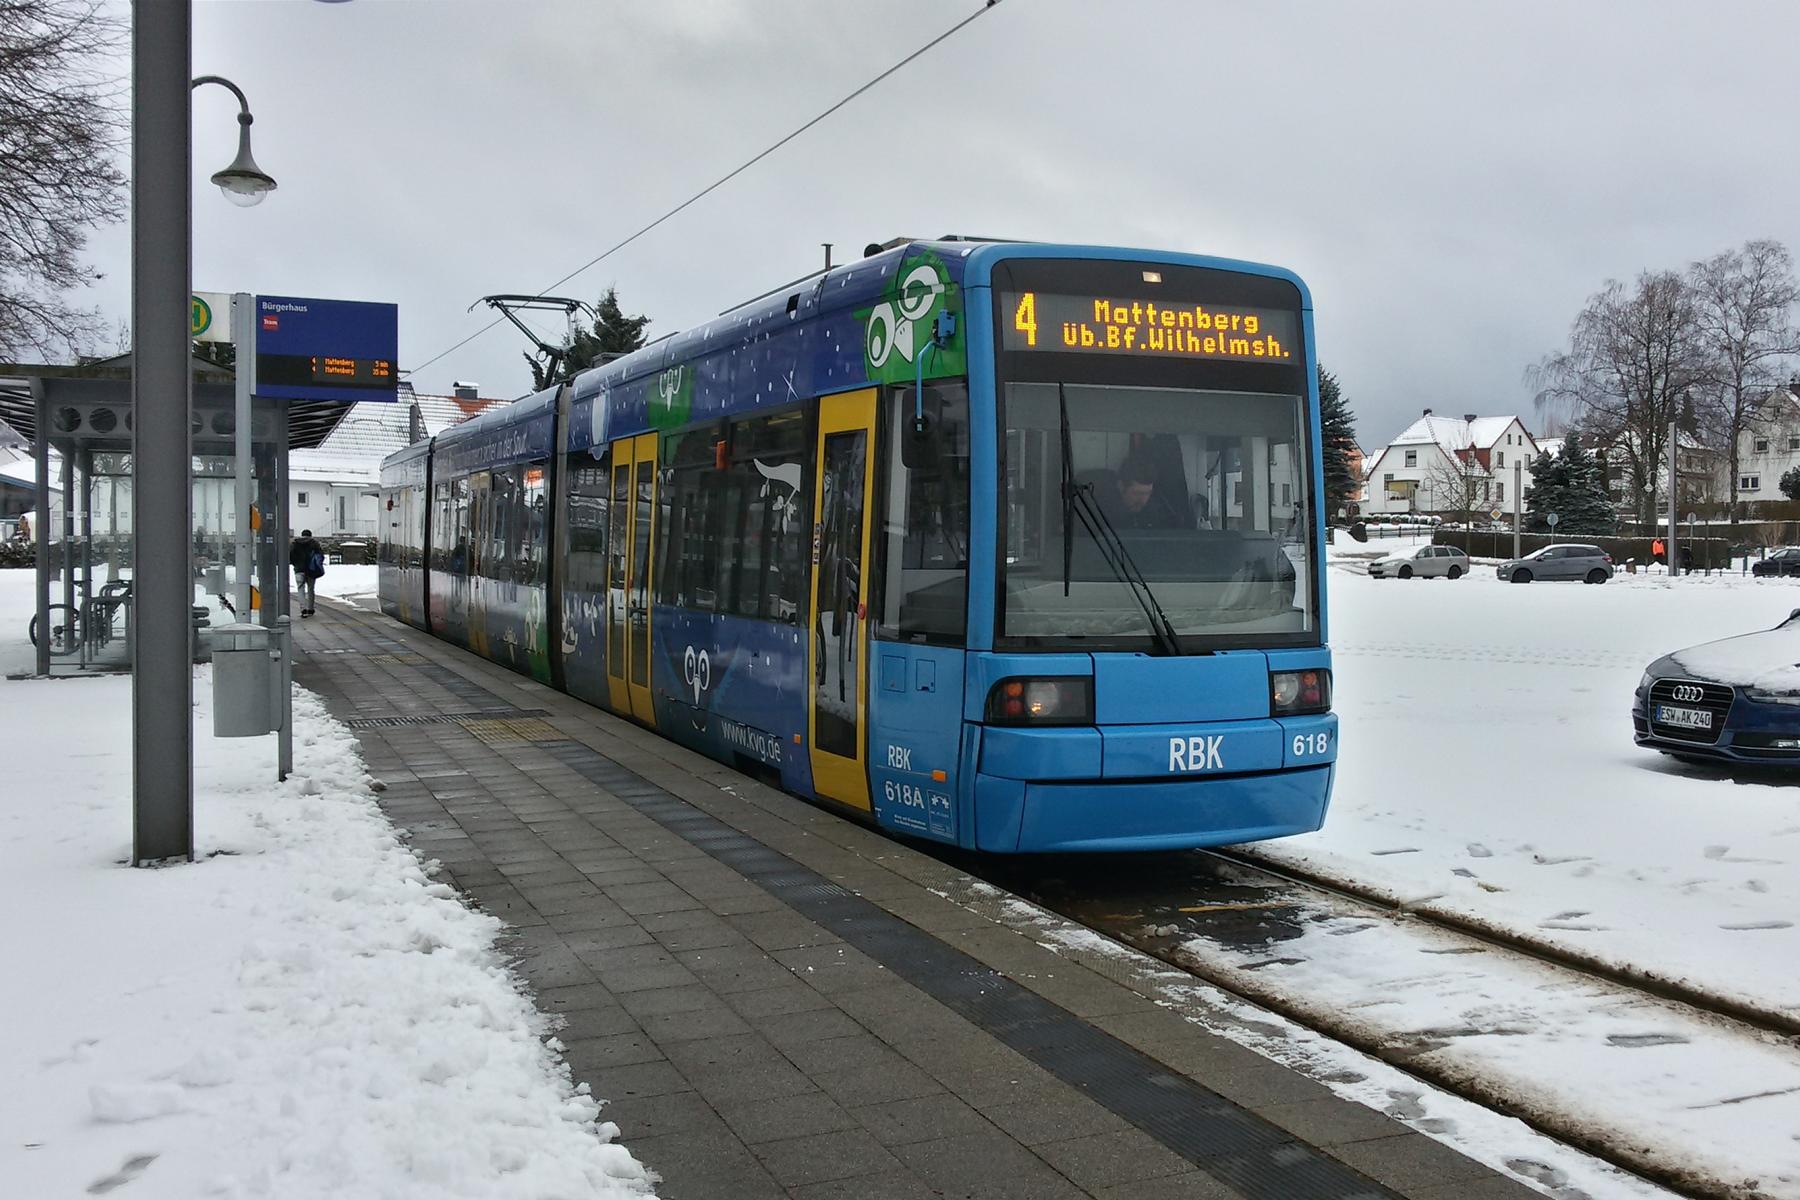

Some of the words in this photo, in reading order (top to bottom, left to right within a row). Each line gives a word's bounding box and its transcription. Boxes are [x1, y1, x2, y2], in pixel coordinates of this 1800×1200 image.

[262, 302, 308, 312] Bürgerhaus
[1015, 292, 1037, 347] 4
[1093, 299, 1260, 334] Mattenberg
[1063, 323, 1290, 358] üb.Bf.Wilhelmsh.
[1661, 707, 1677, 721] ESW
[1682, 711, 1693, 724] AK
[1694, 712, 1711, 727] 240
[721, 720, 781, 762] www.kvg.de
[1168, 735, 1225, 772] RBK
[1293, 732, 1328, 757] 618
[888, 744, 912, 771] RBK
[885, 780, 925, 809] 618A
